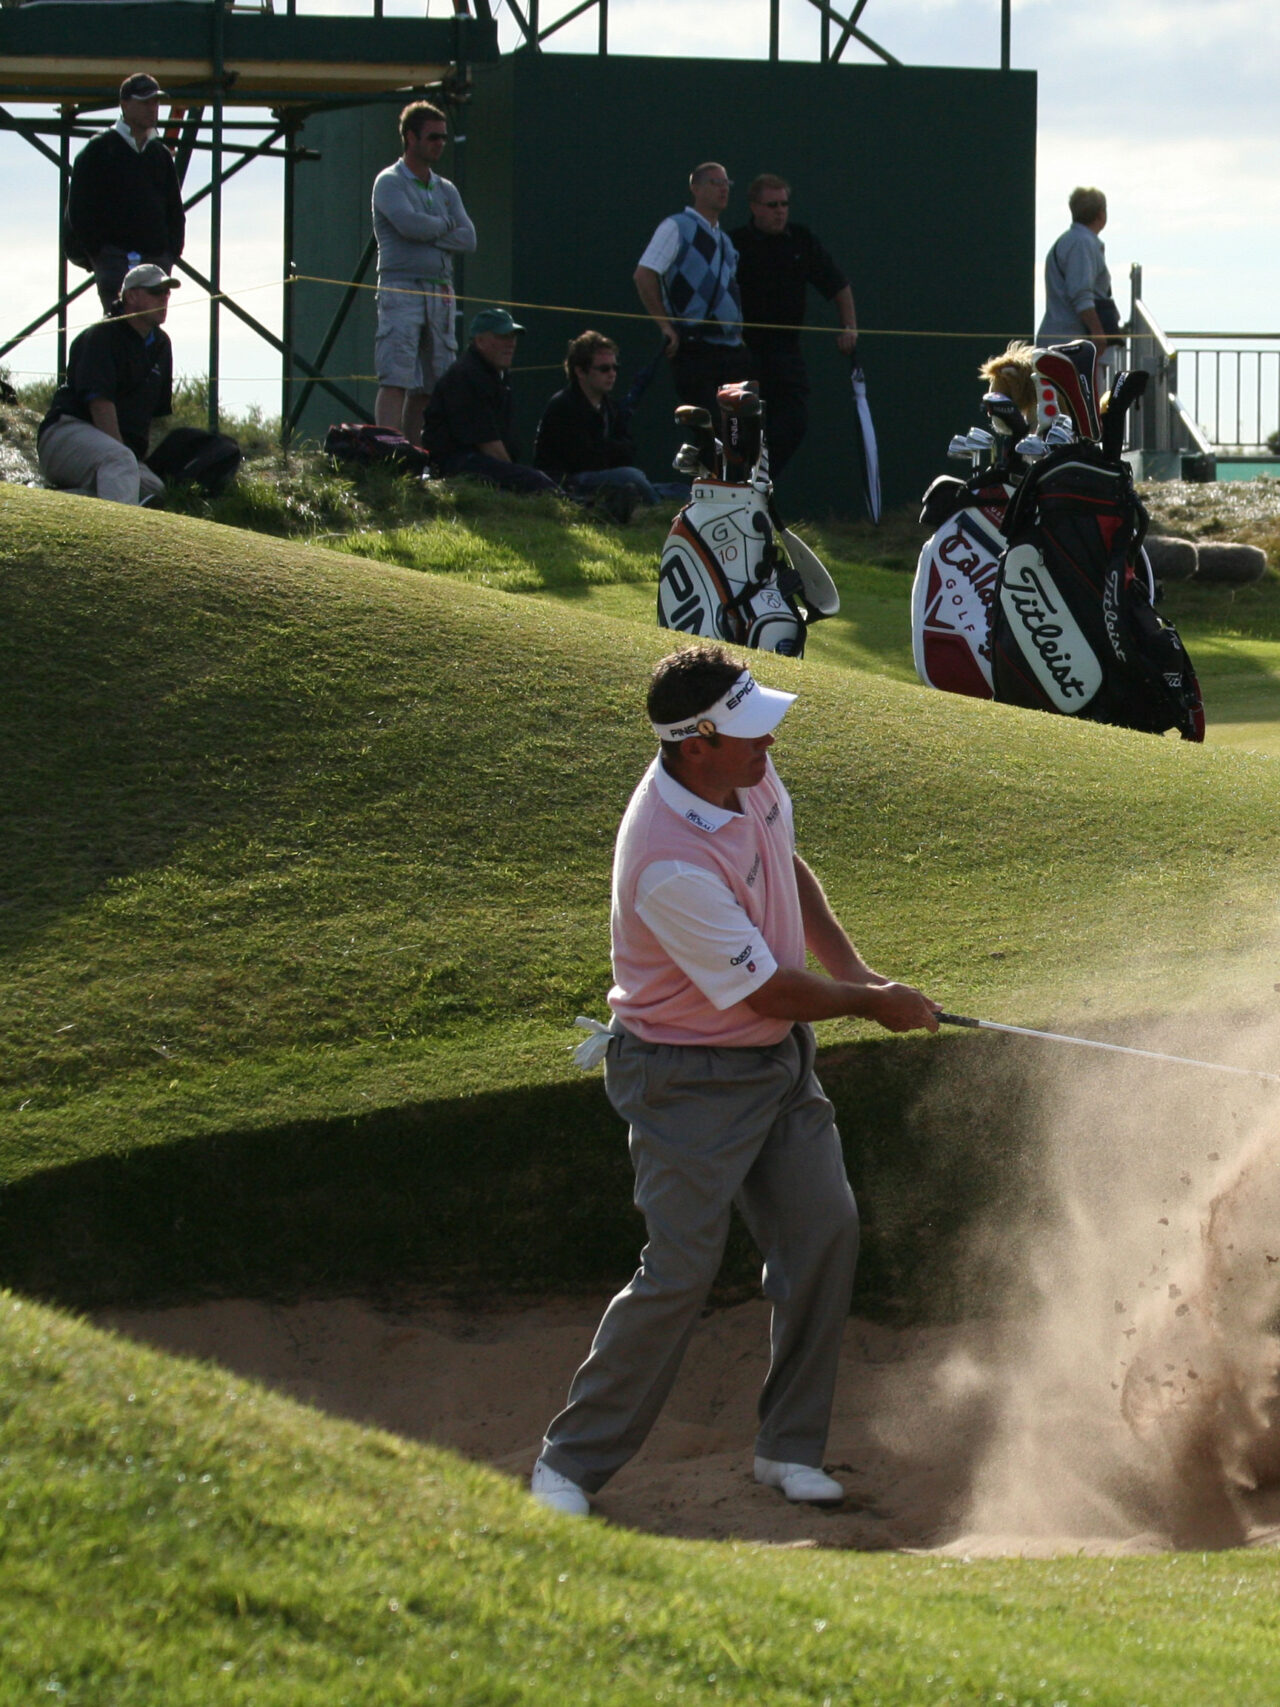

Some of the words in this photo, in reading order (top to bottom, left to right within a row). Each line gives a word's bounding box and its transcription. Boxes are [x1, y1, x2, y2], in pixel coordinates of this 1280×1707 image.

[730, 416, 738, 446] PING
[711, 522, 729, 542] G
[718, 545, 738, 565] 10
[945, 578, 976, 633] GOLF
[1102, 570, 1127, 663] Titleist
[1001, 566, 1085, 698] Titleist
